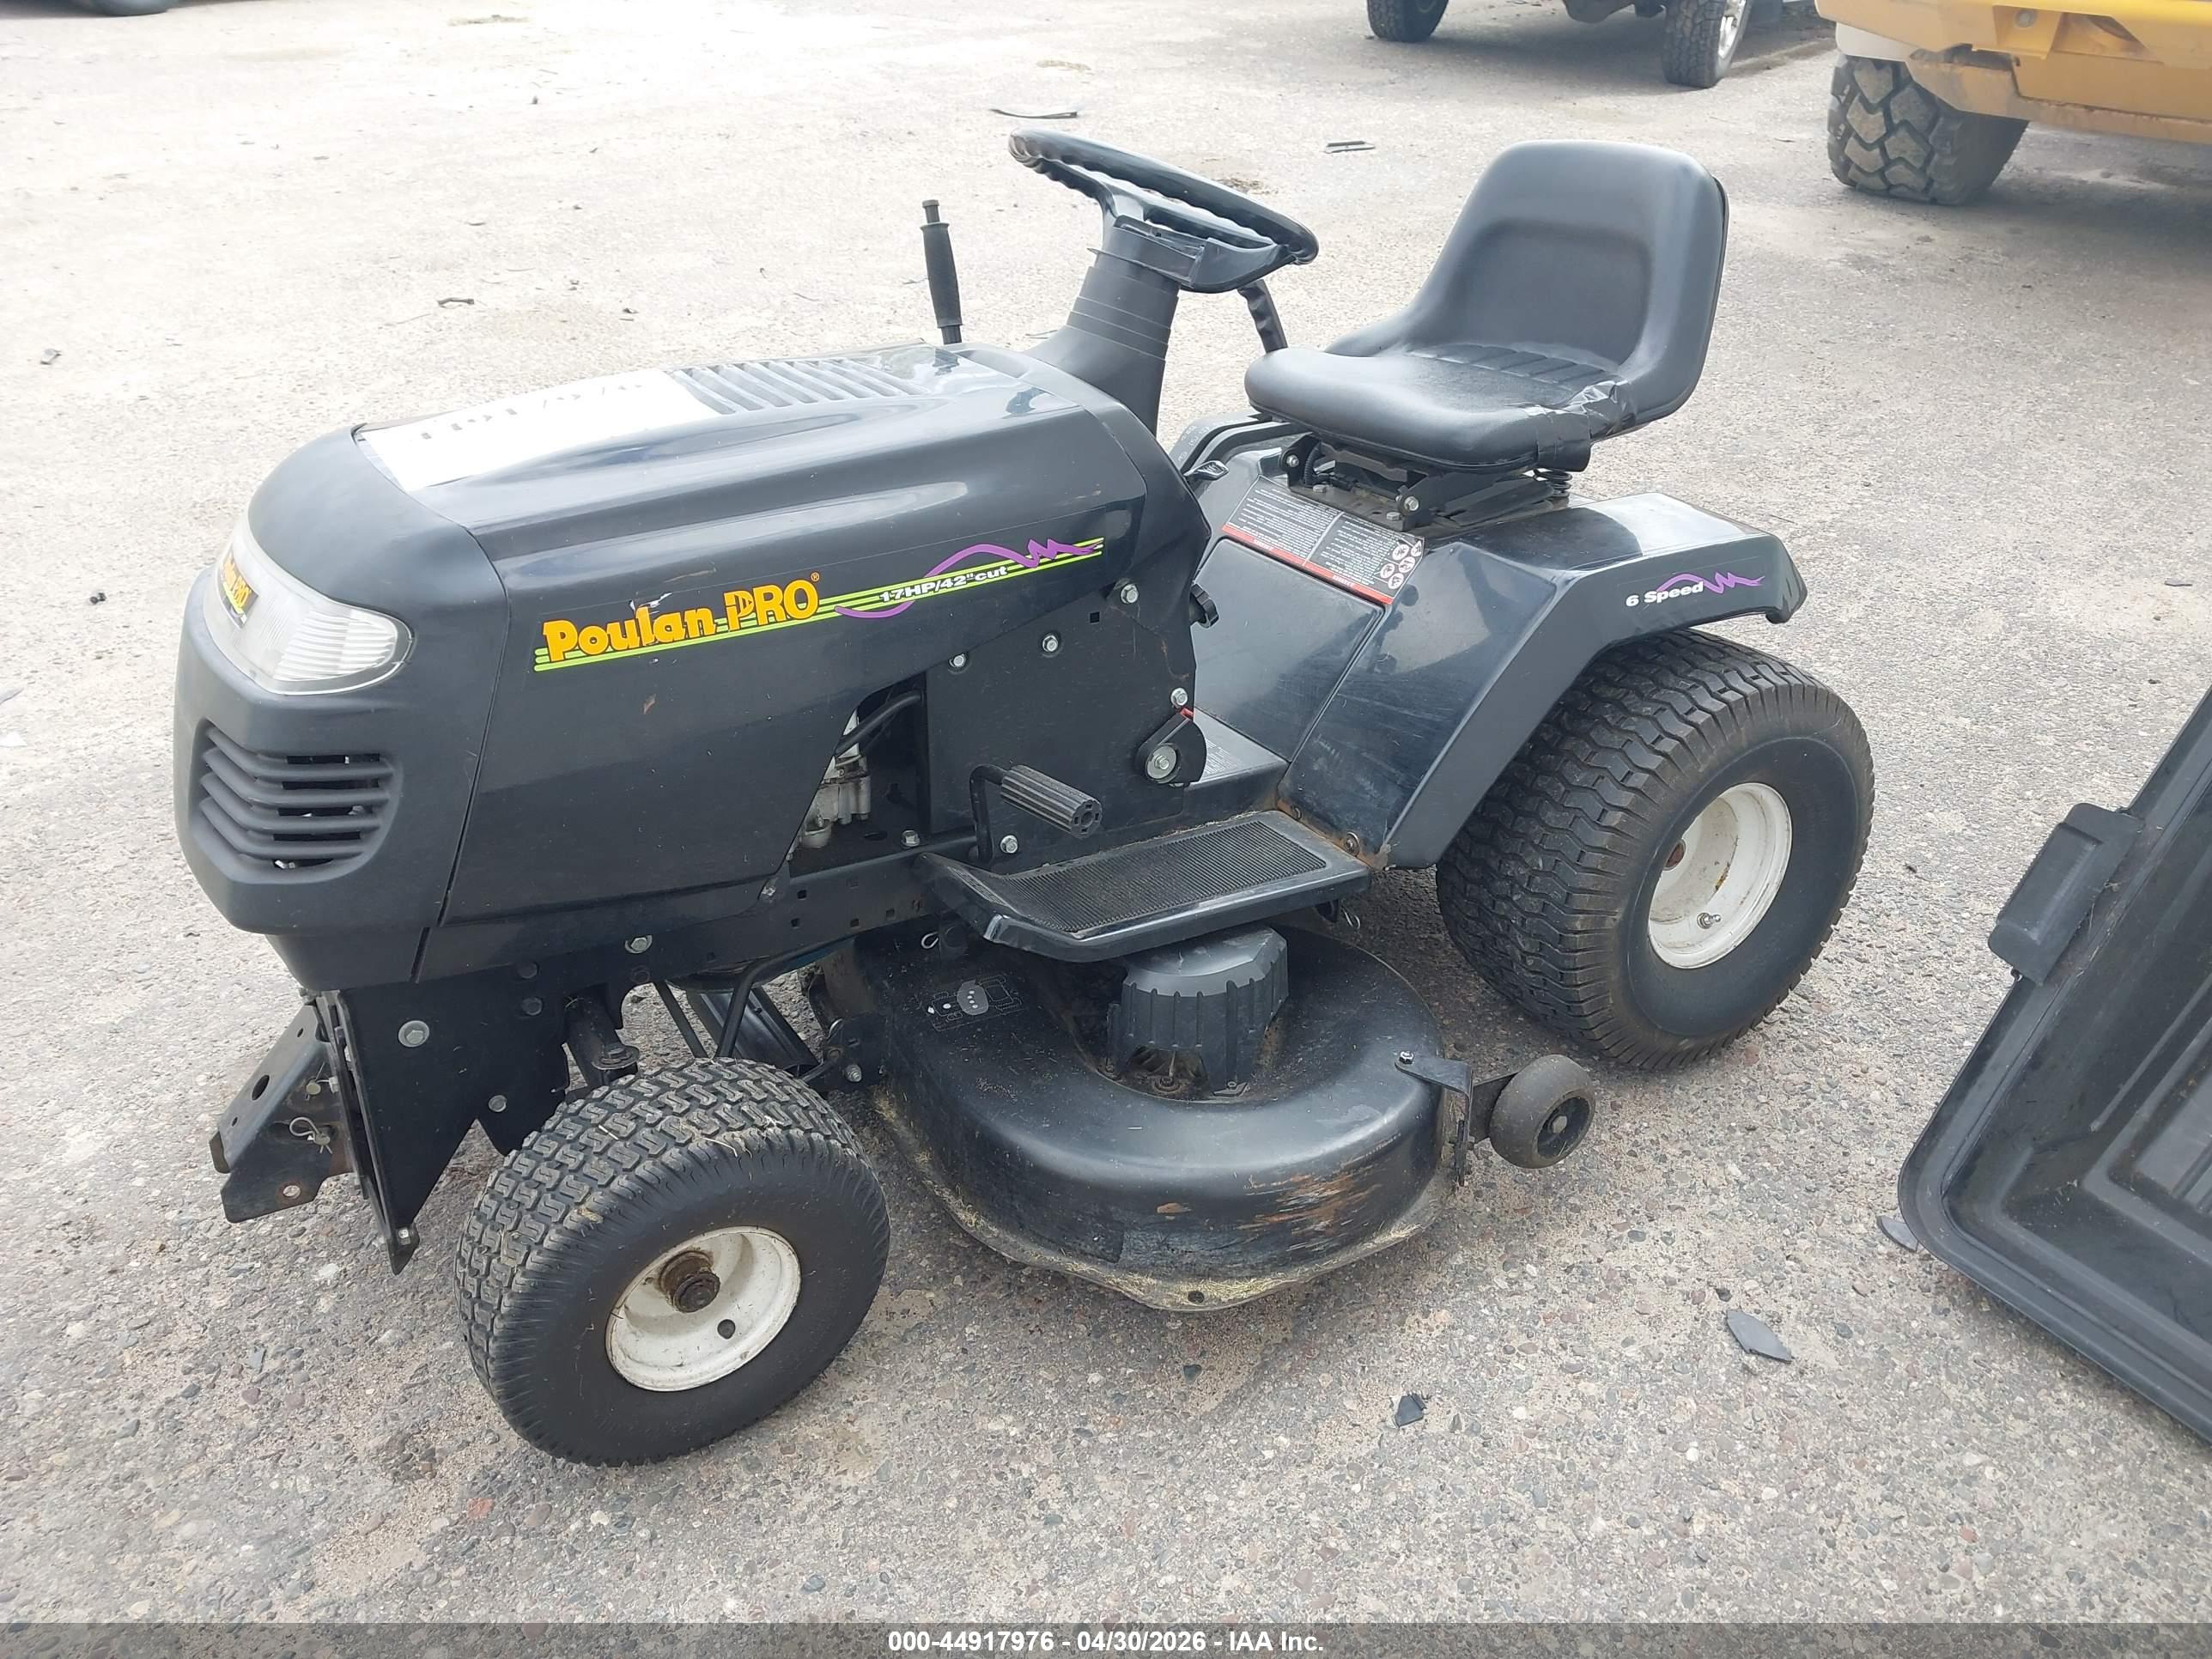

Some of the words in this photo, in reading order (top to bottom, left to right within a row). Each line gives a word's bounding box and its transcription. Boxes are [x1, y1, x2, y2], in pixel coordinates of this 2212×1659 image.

[543, 606, 716, 662] Poulan
[724, 579, 818, 631] PRO
[1626, 594, 1639, 607] 6
[1644, 581, 1704, 604] Speed
